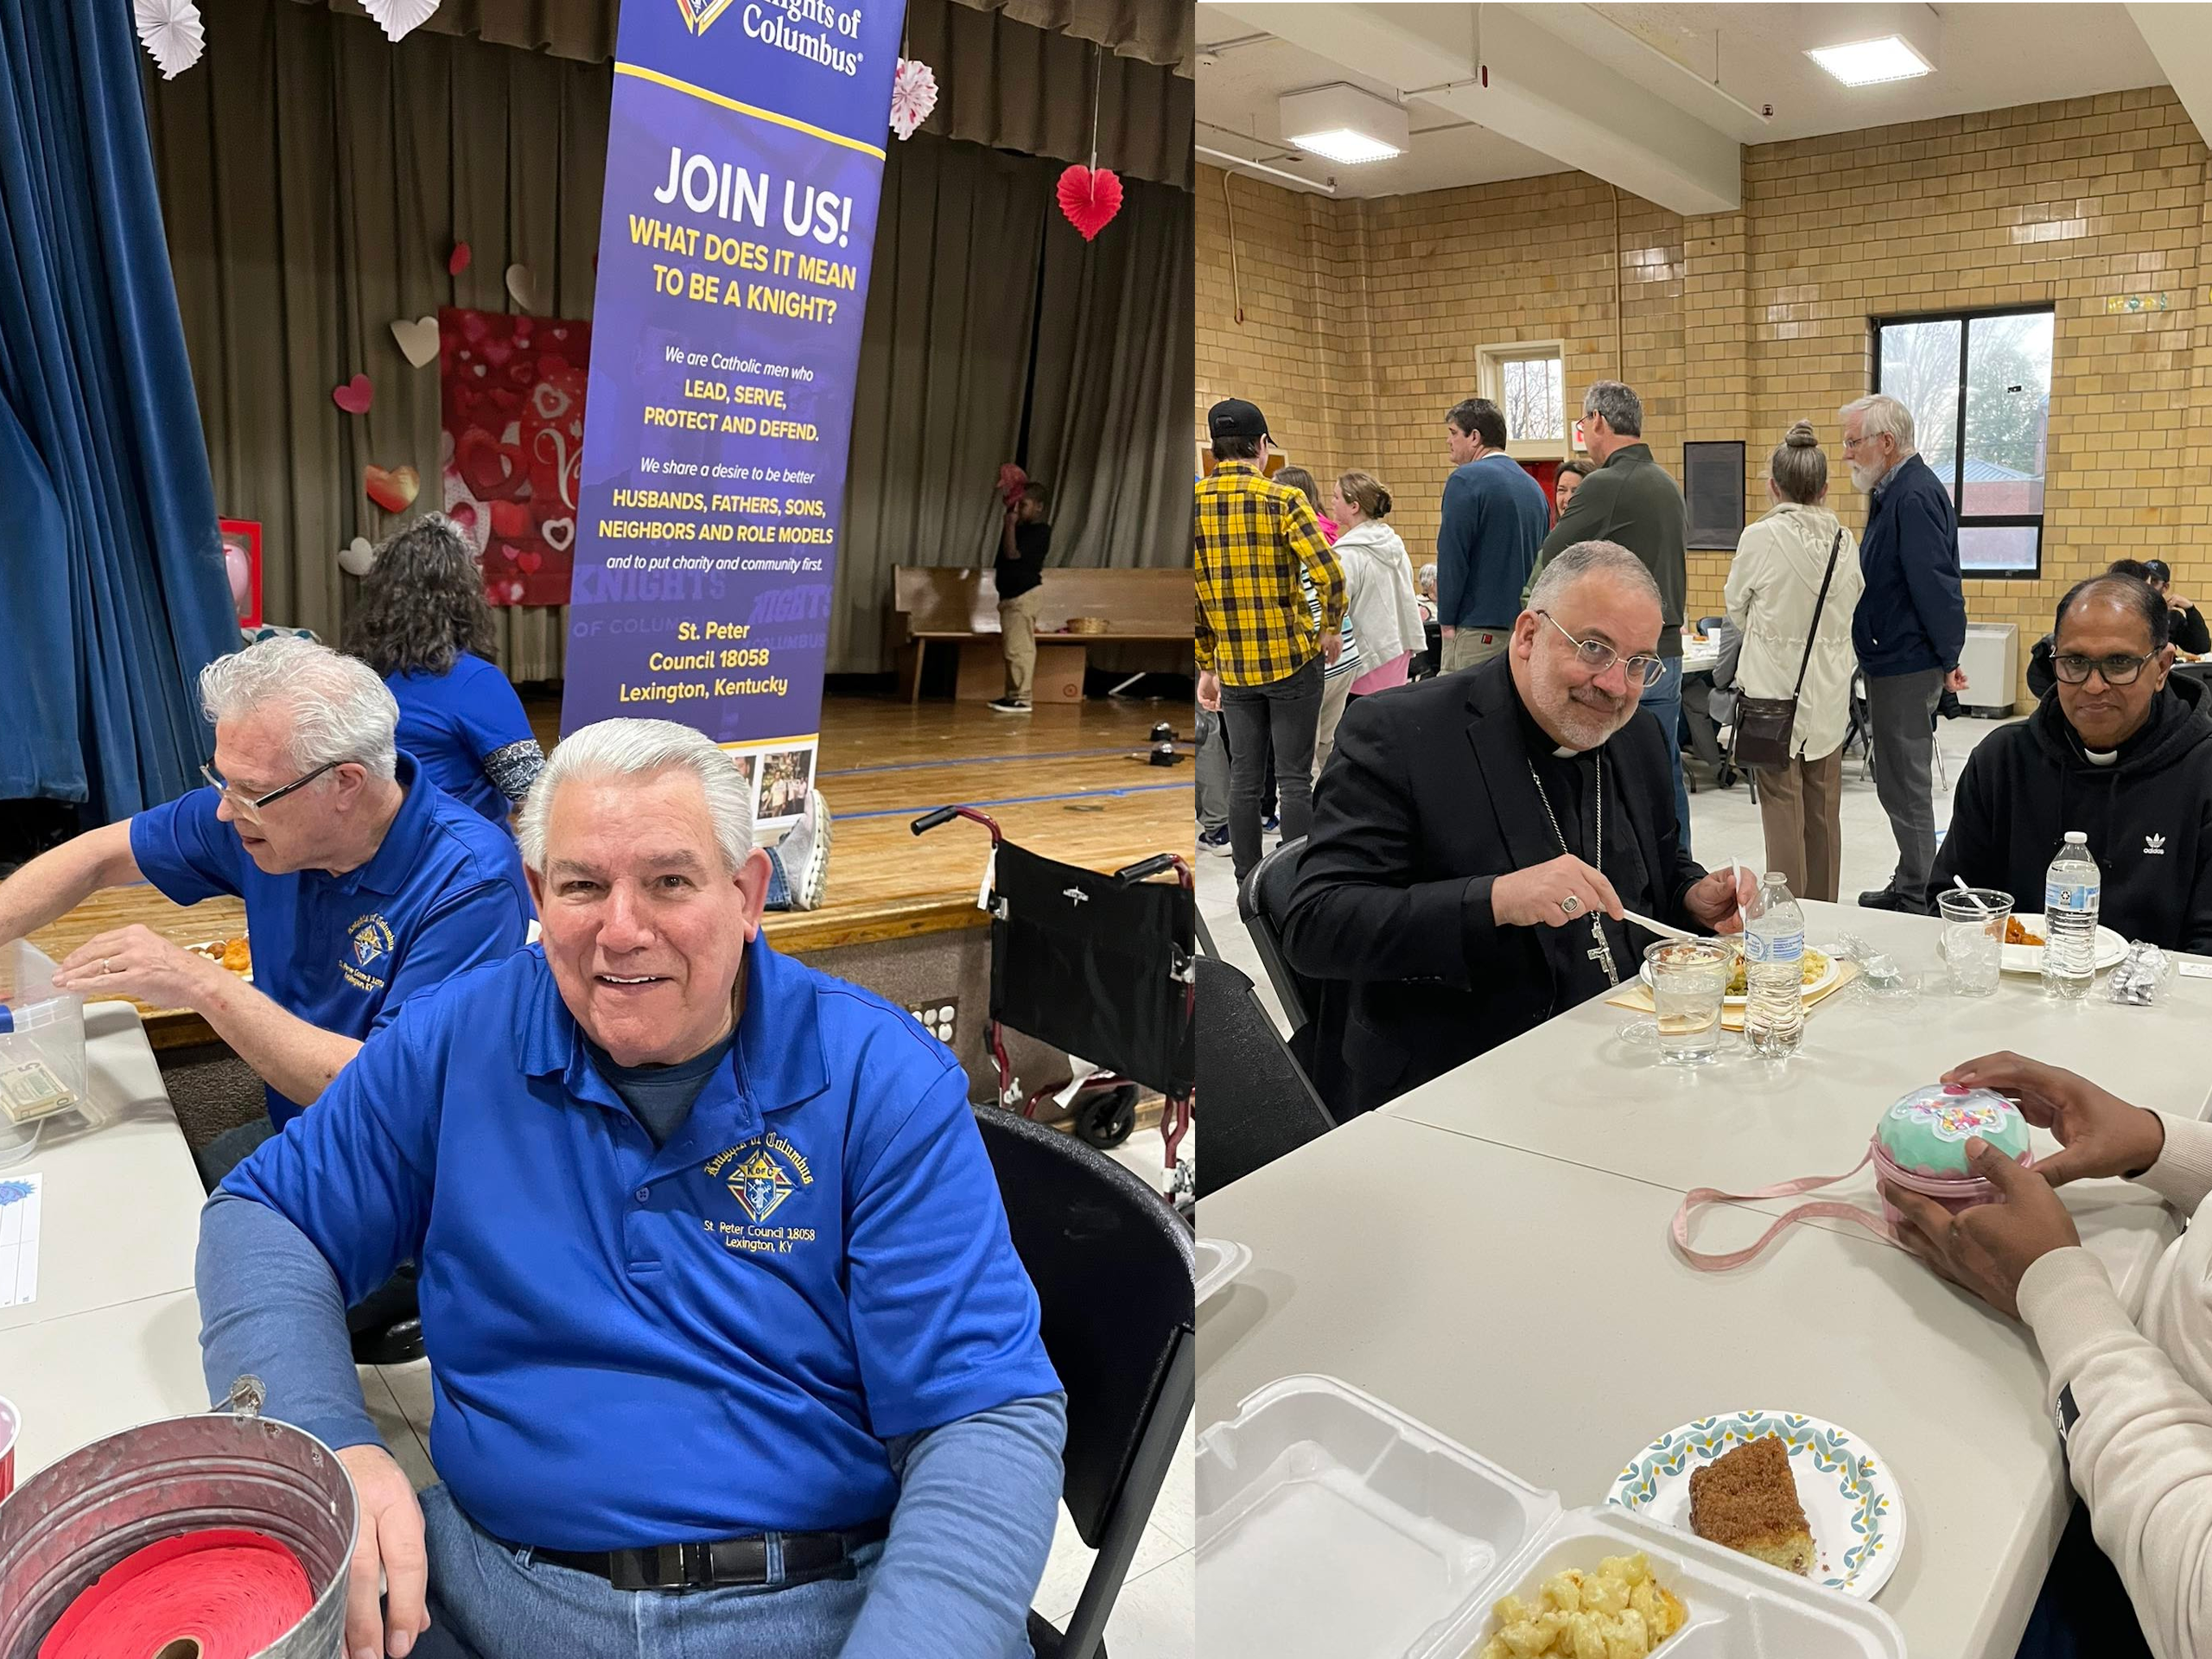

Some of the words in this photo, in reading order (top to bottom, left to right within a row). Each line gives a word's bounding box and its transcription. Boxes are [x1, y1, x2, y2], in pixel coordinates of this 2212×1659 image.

[837, 9, 861, 39] of
[653, 146, 769, 227] JOIN
[783, 180, 853, 248] US!
[629, 213, 700, 257] WHAT
[704, 233, 769, 272] DOES
[773, 249, 794, 276] IT
[798, 254, 856, 290] MEAN
[653, 264, 684, 296] TO
[689, 272, 720, 303] BE
[723, 281, 741, 308] A
[747, 284, 837, 325] KNIGHT?
[665, 346, 684, 364] We
[687, 353, 708, 367] are
[711, 353, 762, 374] Catholic
[763, 363, 789, 378] men
[791, 366, 814, 382] who
[684, 378, 730, 404] LEAD,
[734, 385, 787, 410] SERVE,
[644, 406, 718, 431] PROTECT
[721, 416, 756, 435] AND
[760, 419, 819, 442] DEFEND.
[640, 457, 659, 474] We
[662, 460, 697, 476] share
[701, 464, 709, 477] a
[712, 463, 749, 480] desire
[752, 467, 763, 480] to
[766, 467, 780, 482] be
[782, 468, 815, 485] better
[613, 488, 708, 513] HUSBANDS,
[711, 494, 782, 517] FATHERS,
[785, 499, 826, 518] SONS,
[599, 520, 696, 541] NEIGHBORS
[698, 524, 734, 541] AND
[737, 525, 775, 543] ROLE
[779, 527, 834, 544] MODELS
[607, 554, 632, 569] and
[634, 556, 646, 569] to
[648, 556, 671, 572] put
[672, 555, 714, 573] charity
[716, 556, 740, 570] and
[741, 557, 801, 574] community
[677, 621, 700, 640] St.
[705, 621, 750, 639] Peter
[649, 651, 715, 671] Council
[720, 649, 770, 668] 18058
[620, 682, 709, 703] Lexington,
[715, 676, 788, 696] Kentucky
[766, 1132, 814, 1185] Columbus
[720, 1222, 744, 1235] Peter
[747, 1225, 784, 1238] Council
[787, 1227, 816, 1241] 18058
[726, 1235, 776, 1253] Lexington,
[779, 1240, 793, 1253] KY
